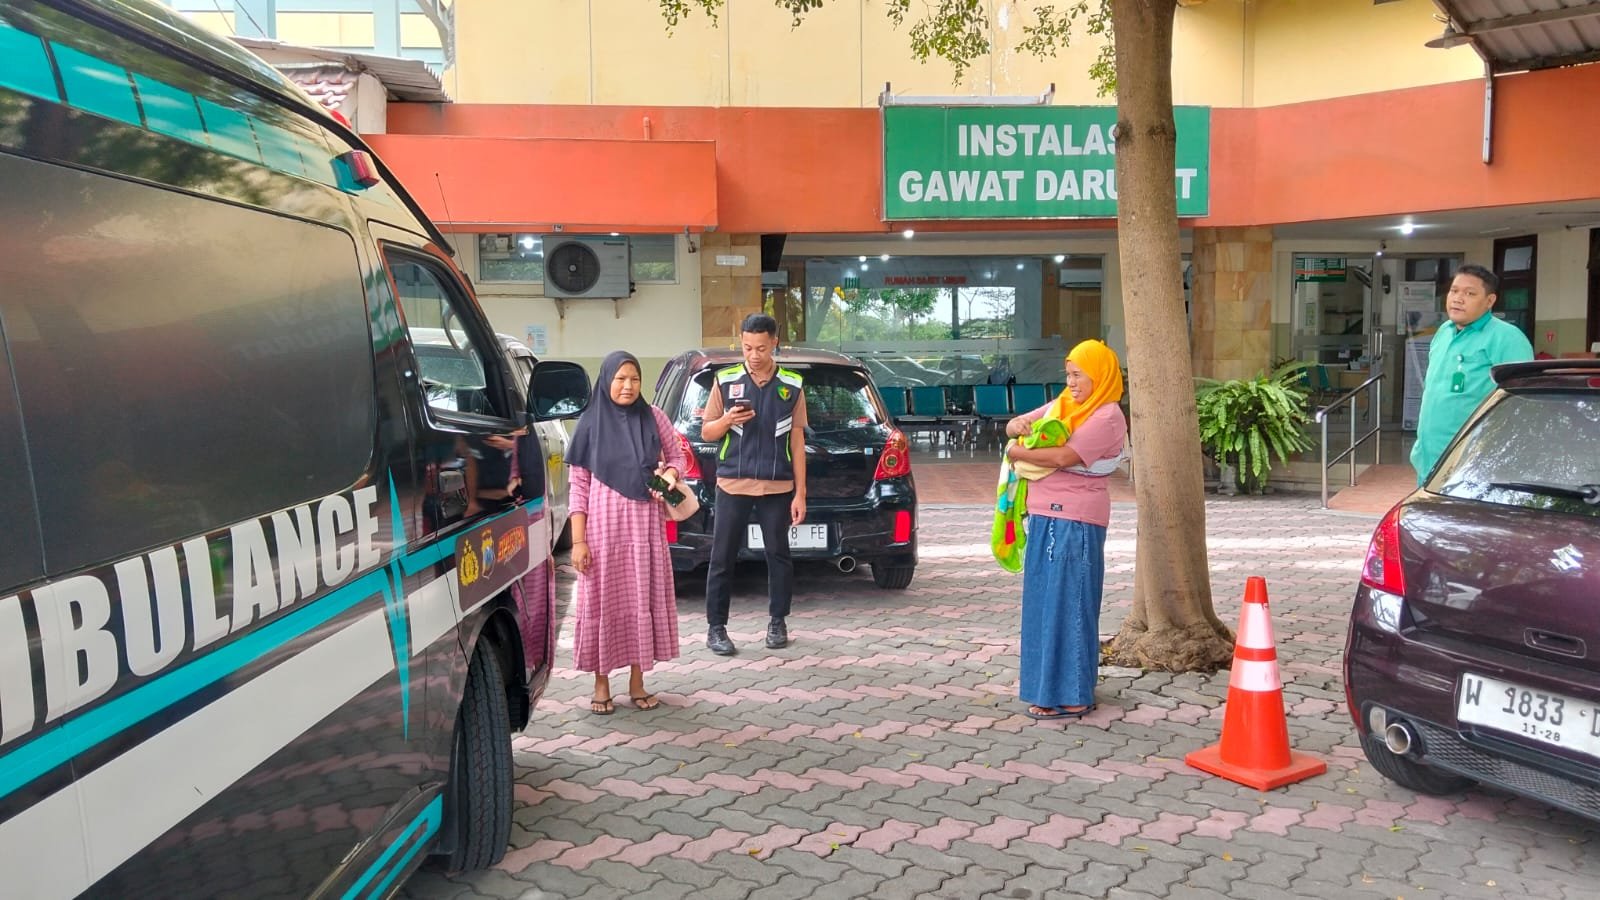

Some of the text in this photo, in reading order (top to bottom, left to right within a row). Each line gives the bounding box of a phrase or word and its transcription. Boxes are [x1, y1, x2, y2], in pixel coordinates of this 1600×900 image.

[958, 124, 1118, 157] INSTALA
[898, 168, 1198, 202] GAWAT DART
[751, 526, 759, 540] L
[811, 526, 825, 540] FE
[1465, 678, 1483, 706] W
[1502, 687, 1565, 726] 1833
[1521, 722, 1561, 742] 11-28
